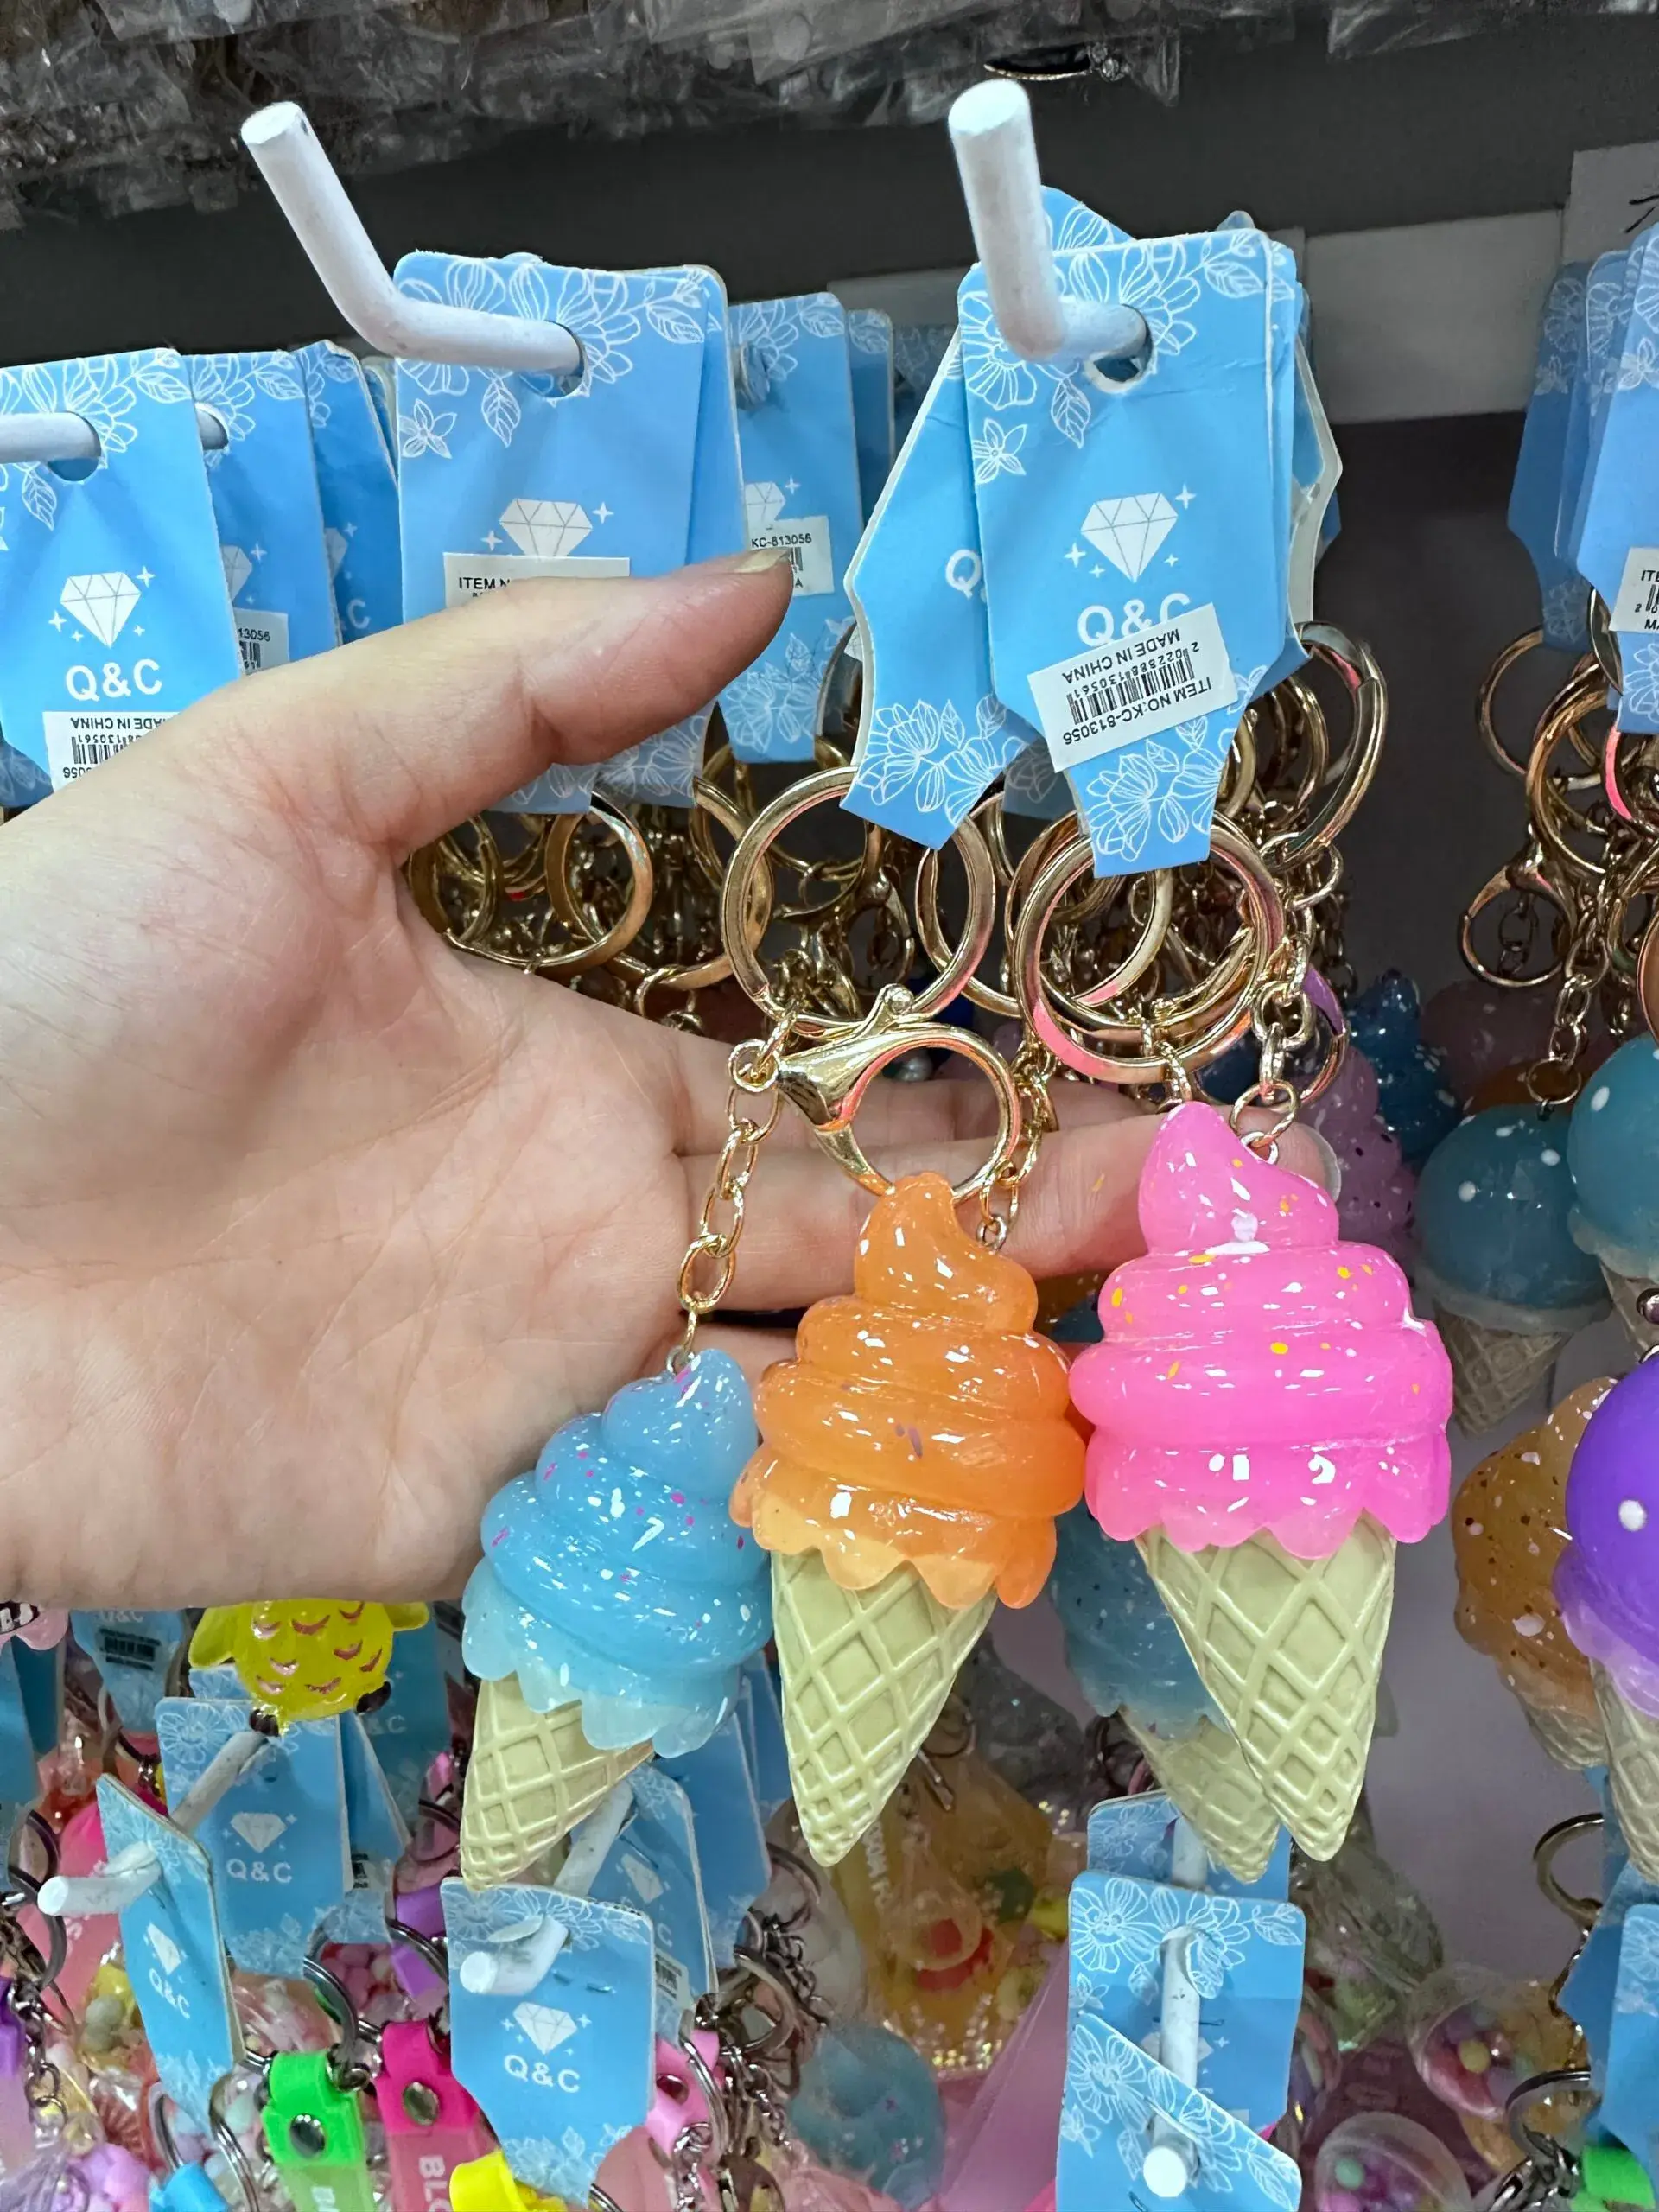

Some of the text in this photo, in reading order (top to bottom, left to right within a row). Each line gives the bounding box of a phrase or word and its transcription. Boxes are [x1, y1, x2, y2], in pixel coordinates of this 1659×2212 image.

[459, 577, 496, 590] ITEM
[1062, 628, 1181, 683] MADE IN CHINA
[66, 658, 162, 702] Q&C
[1175, 677, 1212, 703] ITEM
[70, 717, 166, 730] ADE IN CHINA
[226, 1858, 293, 1885] Q&C
[149, 1967, 190, 2019] Q&C
[504, 2054, 581, 2094] Q&C
